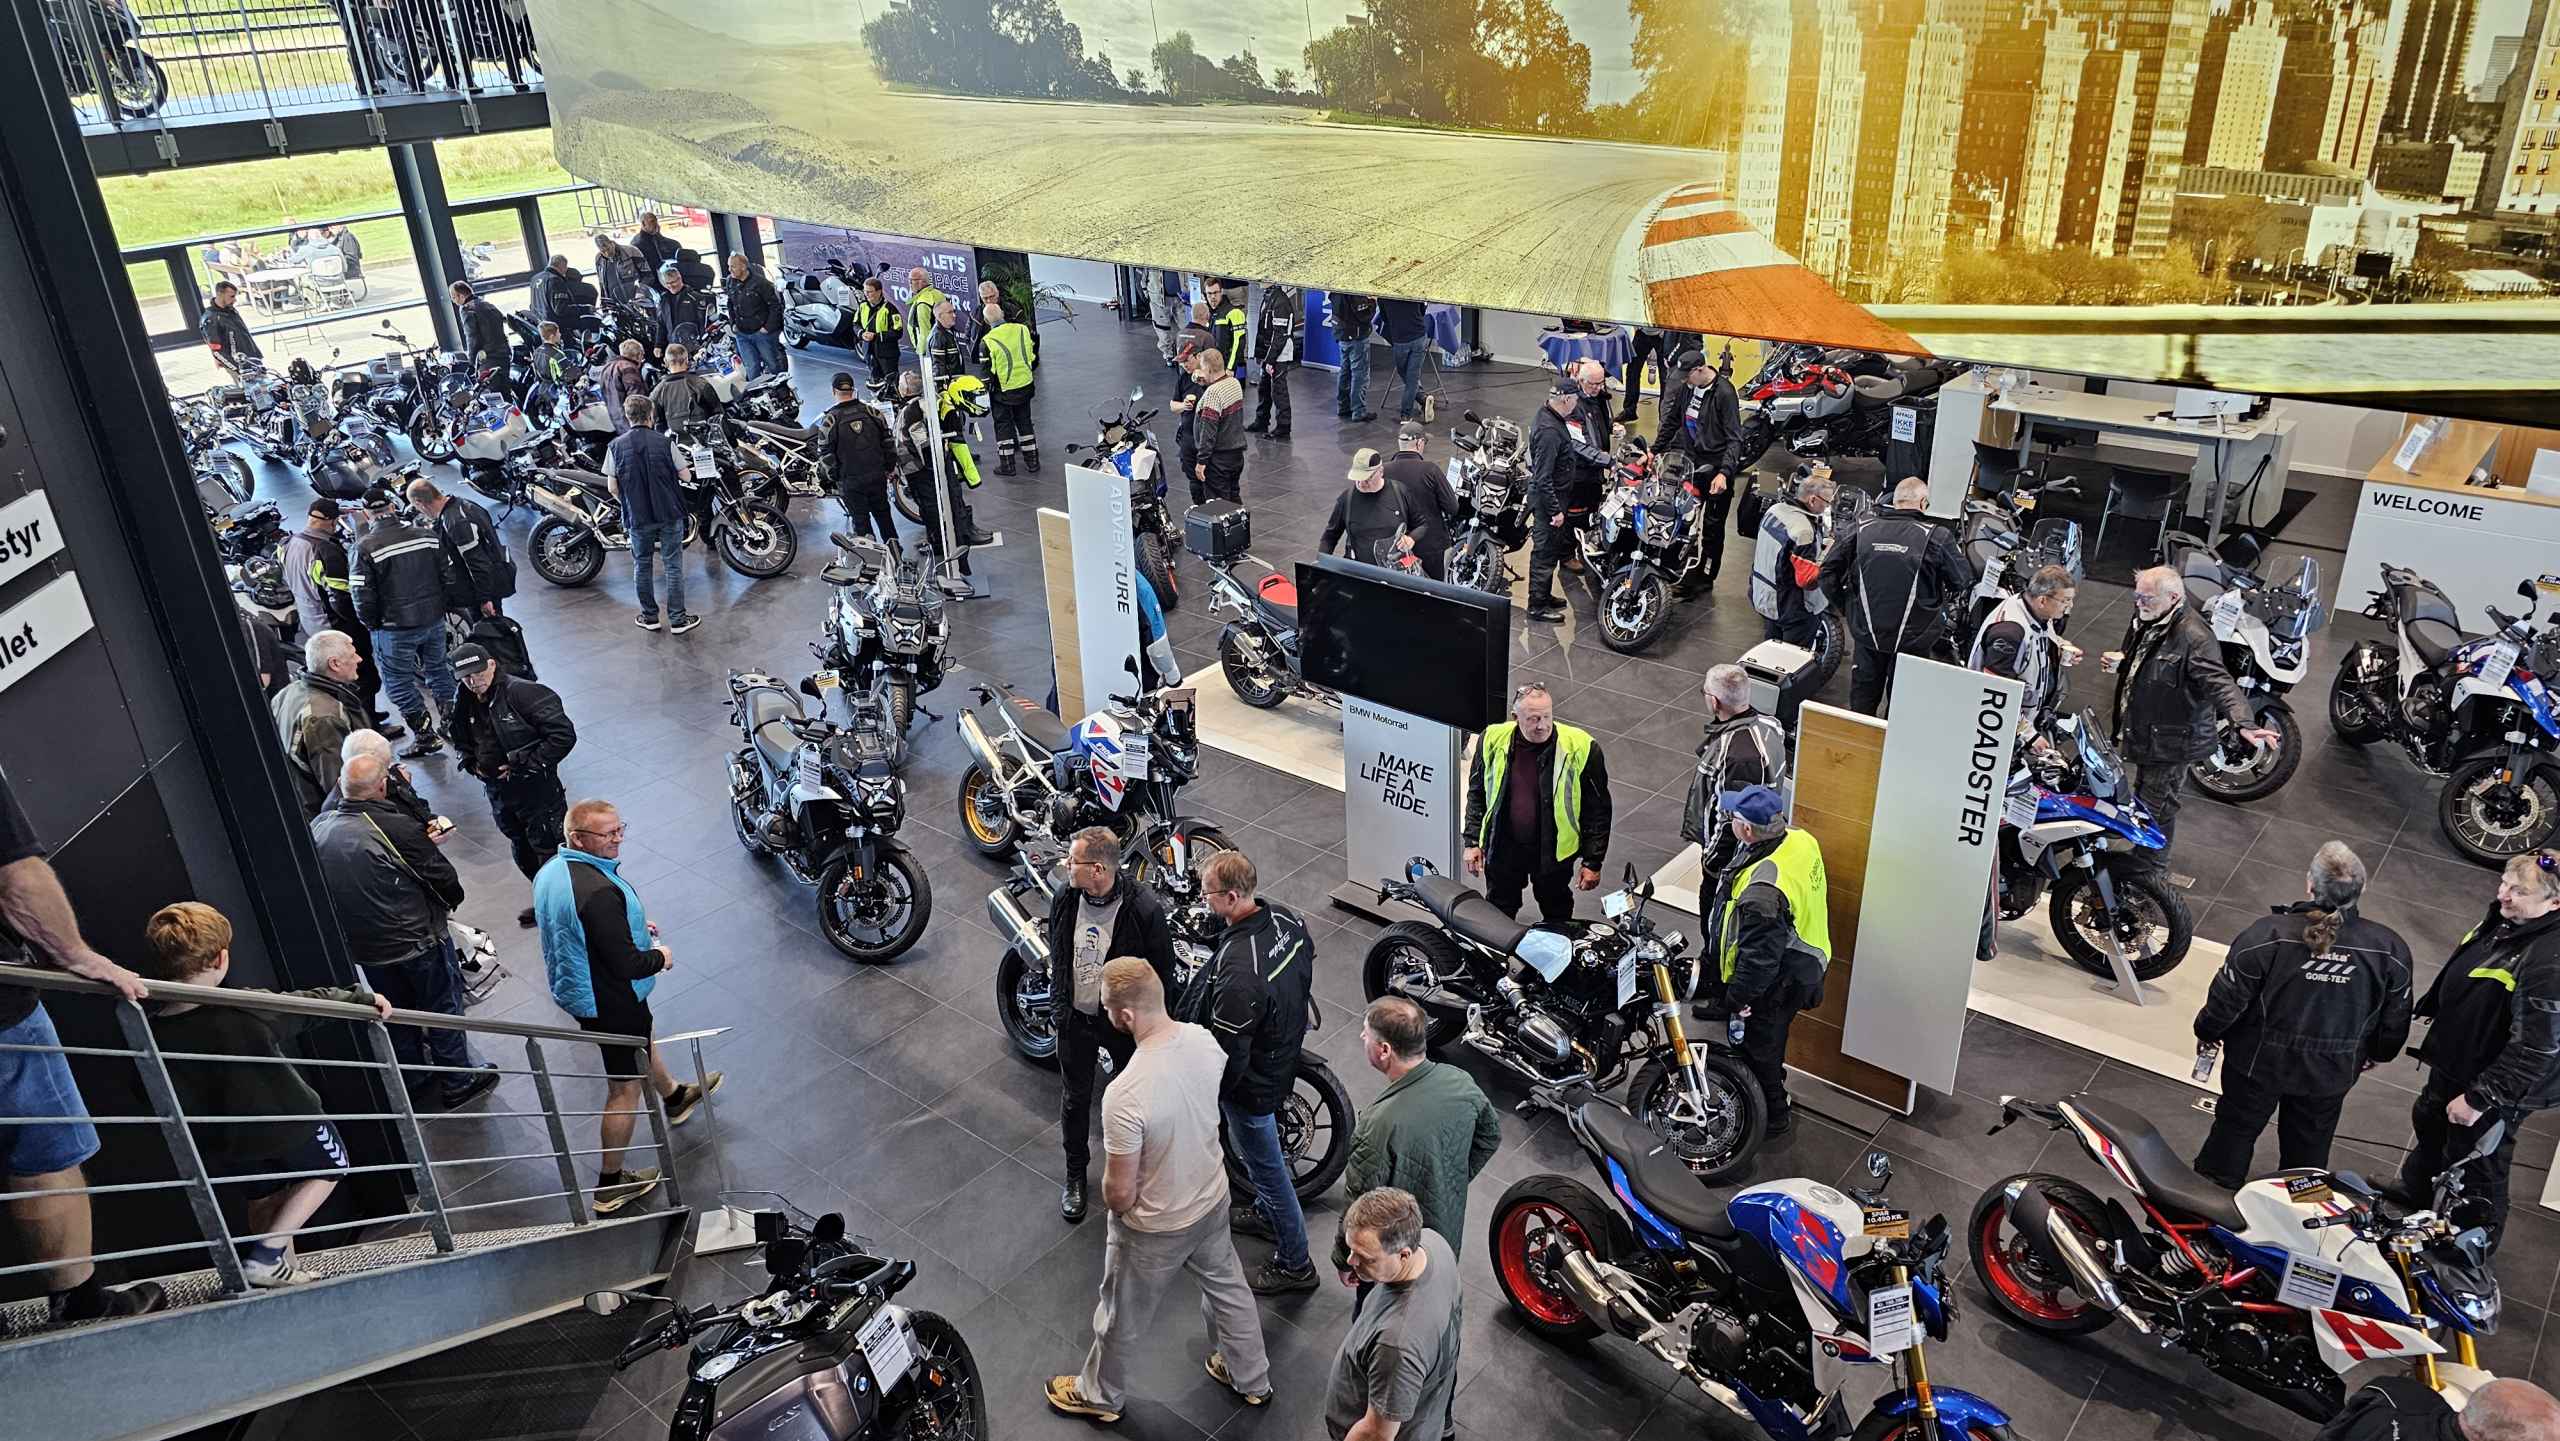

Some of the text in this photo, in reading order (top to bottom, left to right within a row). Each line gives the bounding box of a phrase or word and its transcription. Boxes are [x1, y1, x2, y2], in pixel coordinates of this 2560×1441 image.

[932, 253, 966, 273] LET'S
[935, 273, 968, 292] PACE
[1895, 418, 1913, 427] IKKE
[2373, 491, 2484, 521] WELCOME
[1110, 485, 1130, 615] ADVENTURE
[1349, 705, 1408, 730] BMW Motorrad
[1360, 763, 1415, 795] LIFE A
[1378, 751, 1434, 783] MAKE
[1958, 687, 2008, 847] ROADSTER
[1382, 787, 1429, 817] RIDE.
[2305, 972, 2348, 983] GORE-TEX
[1867, 1215, 1891, 1223] 10.490
